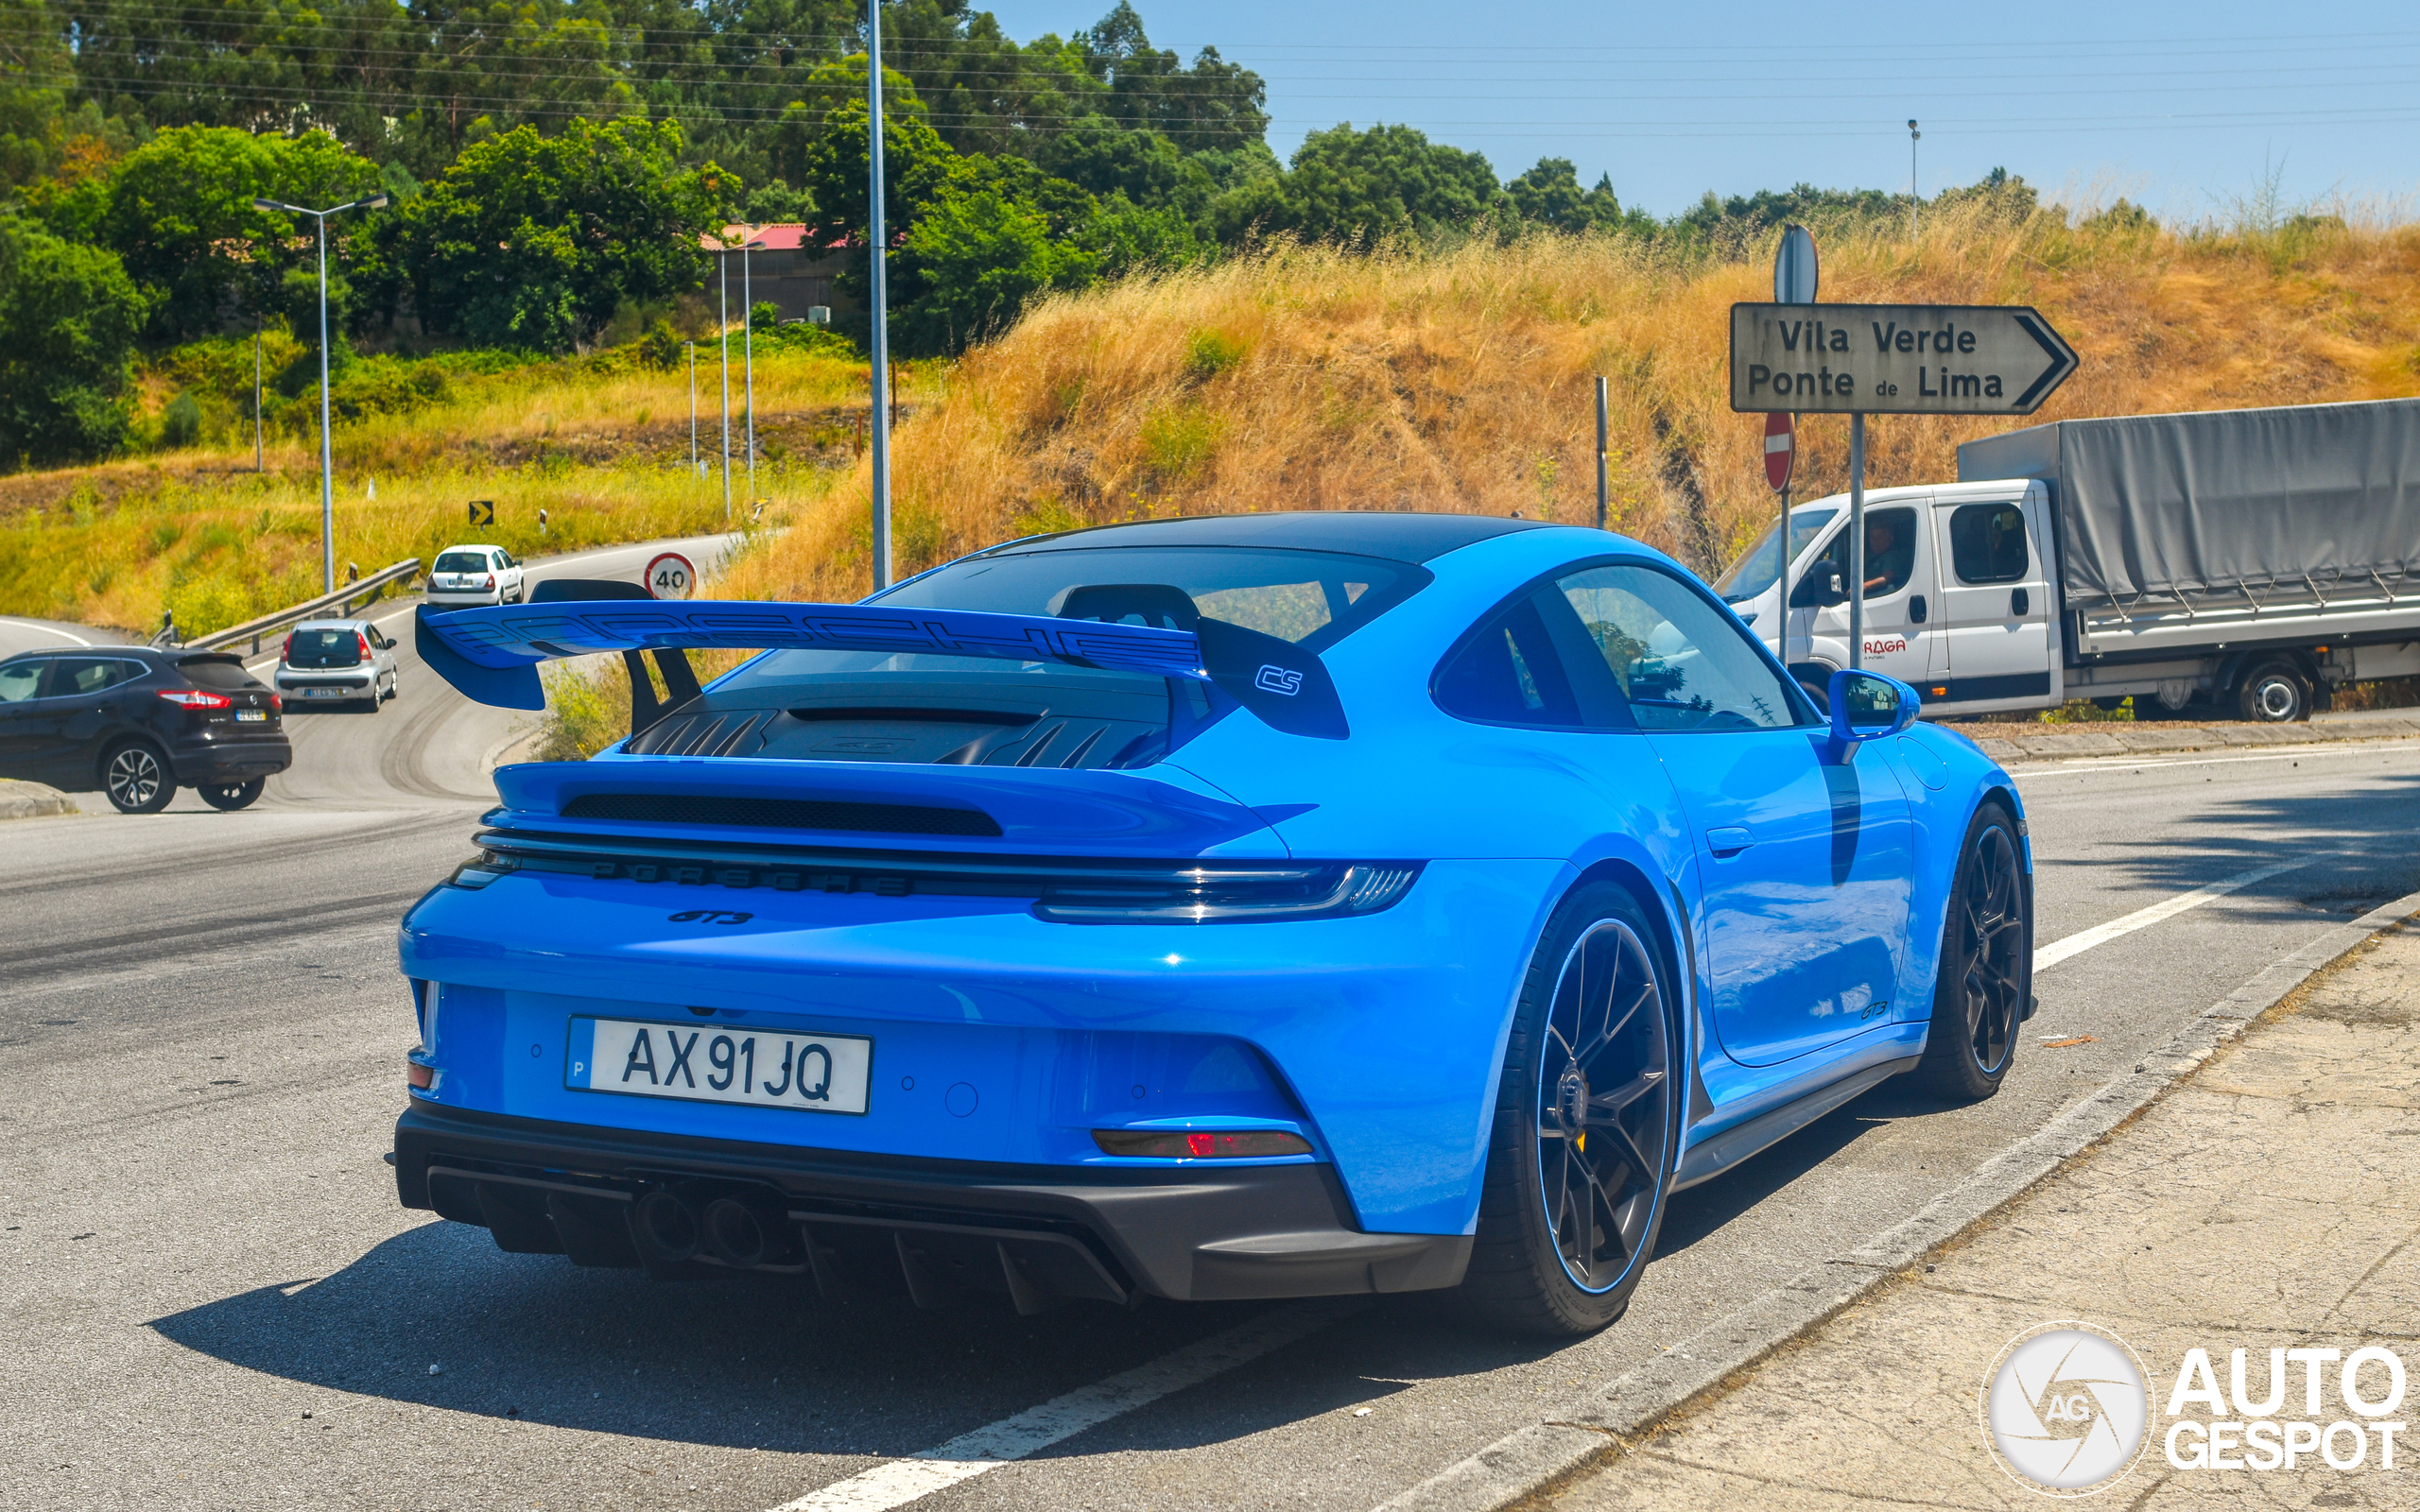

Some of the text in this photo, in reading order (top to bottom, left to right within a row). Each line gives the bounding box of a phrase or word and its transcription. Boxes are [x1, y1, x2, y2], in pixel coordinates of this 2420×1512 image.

[1778, 319, 1977, 353] Vila Verde
[1749, 364, 2004, 398] Ponte de Lima
[655, 570, 684, 589] 40
[430, 612, 1200, 672] PORSCHE
[1254, 664, 1304, 696] CS
[592, 862, 914, 897] PORSCHE
[667, 909, 754, 925] GT3
[1860, 1000, 1888, 1021] GT3
[573, 1061, 584, 1077] P
